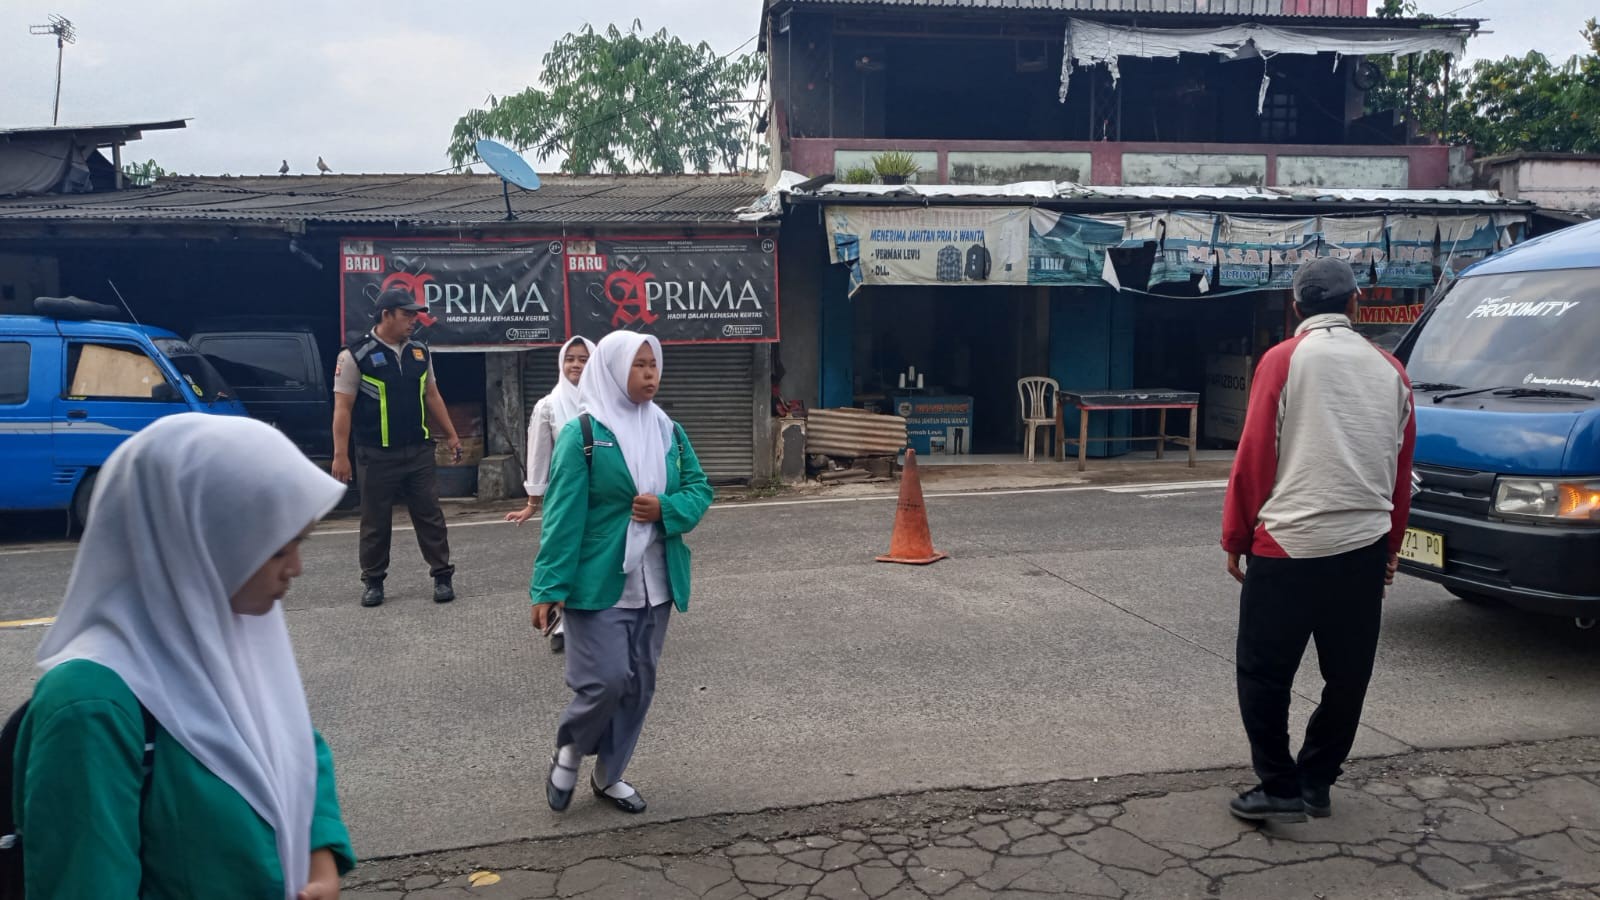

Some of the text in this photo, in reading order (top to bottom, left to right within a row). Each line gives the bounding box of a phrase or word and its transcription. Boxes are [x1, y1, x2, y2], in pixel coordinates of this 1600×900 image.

[870, 229, 906, 241] MENERIMA
[908, 229, 936, 242] JAHITAN
[936, 230, 952, 241] PRIA
[959, 230, 985, 242] WANITA
[875, 248, 902, 260] VERMAK
[345, 256, 380, 271] BARU
[569, 256, 603, 271] BARU
[1359, 305, 1425, 324] MINAN
[1465, 301, 1580, 319] PROXIMITY
